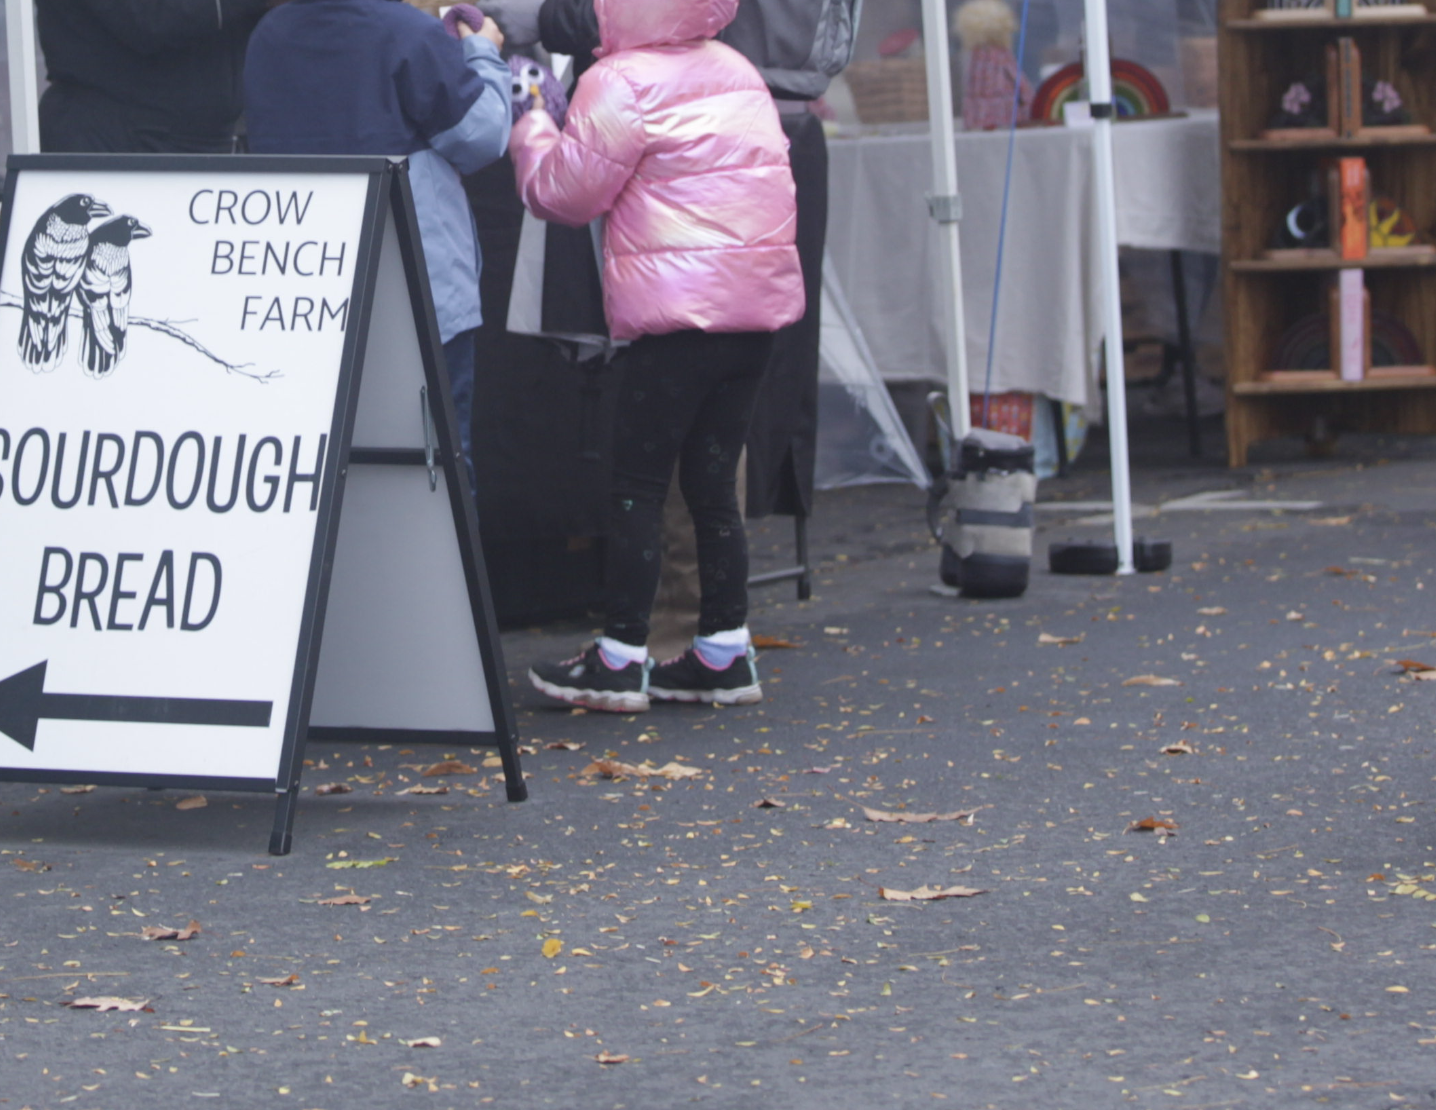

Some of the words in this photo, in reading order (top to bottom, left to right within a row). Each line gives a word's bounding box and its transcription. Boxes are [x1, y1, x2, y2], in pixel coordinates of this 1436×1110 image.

[188, 188, 314, 225] CROW
[210, 240, 346, 277] BENCH
[240, 296, 350, 332] FARM
[32, 546, 223, 632] BREAD
